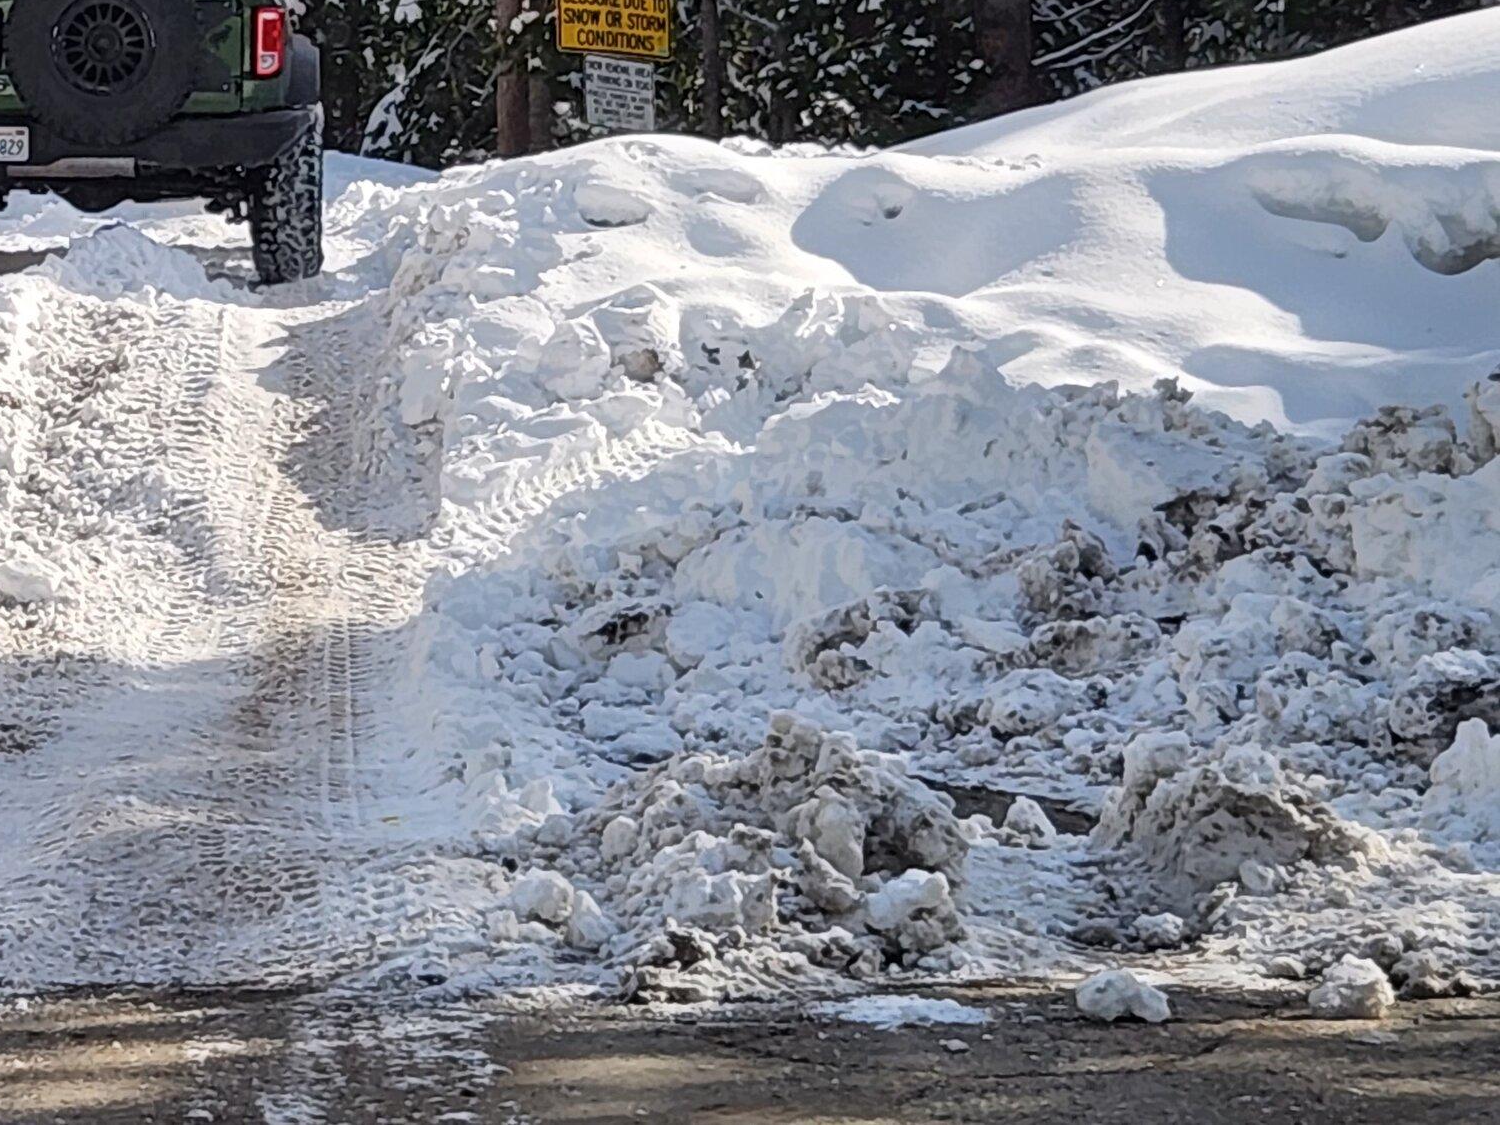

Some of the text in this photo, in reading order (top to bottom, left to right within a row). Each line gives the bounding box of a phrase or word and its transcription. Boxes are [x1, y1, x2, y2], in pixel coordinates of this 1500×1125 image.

[563, 7, 667, 33] SNOW OR STORM
[577, 28, 655, 52] CONDITIONS
